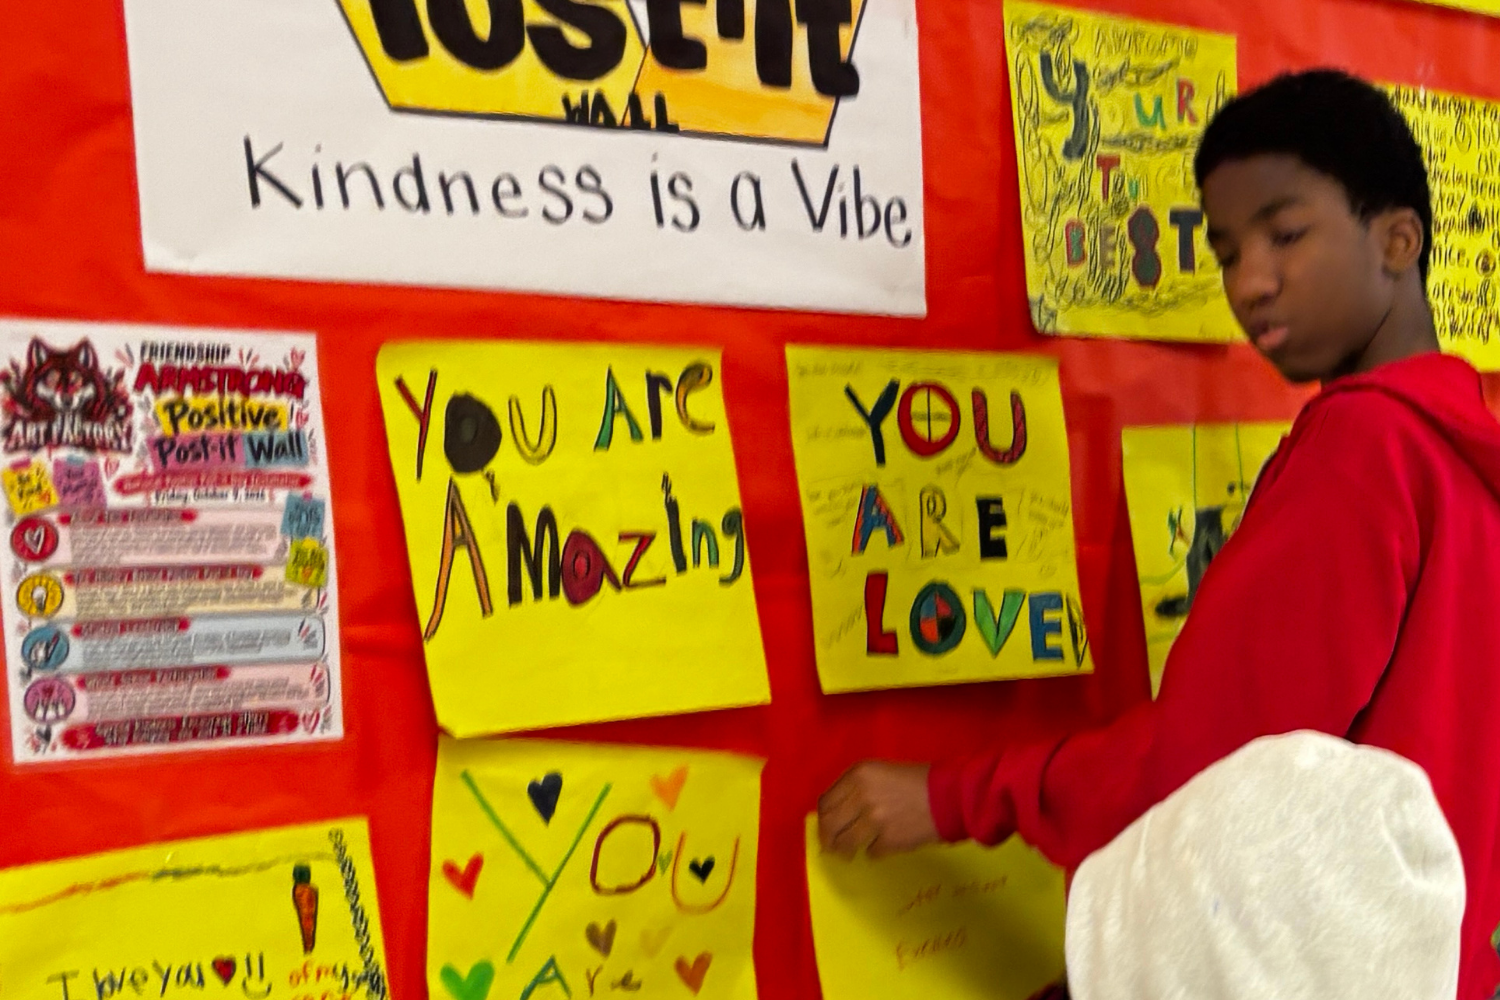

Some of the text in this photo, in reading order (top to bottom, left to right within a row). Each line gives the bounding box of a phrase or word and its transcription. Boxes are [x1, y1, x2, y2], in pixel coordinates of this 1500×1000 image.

[561, 89, 680, 133] WALL
[242, 134, 913, 248] Kindness is a Vibe
[139, 341, 231, 364] FRIENDSHIP
[133, 362, 307, 398] ARMSTRONG
[164, 400, 281, 434] Positive
[844, 377, 1028, 467] YOU
[154, 430, 305, 469] Post-it Wall
[851, 484, 1008, 561] ARE
